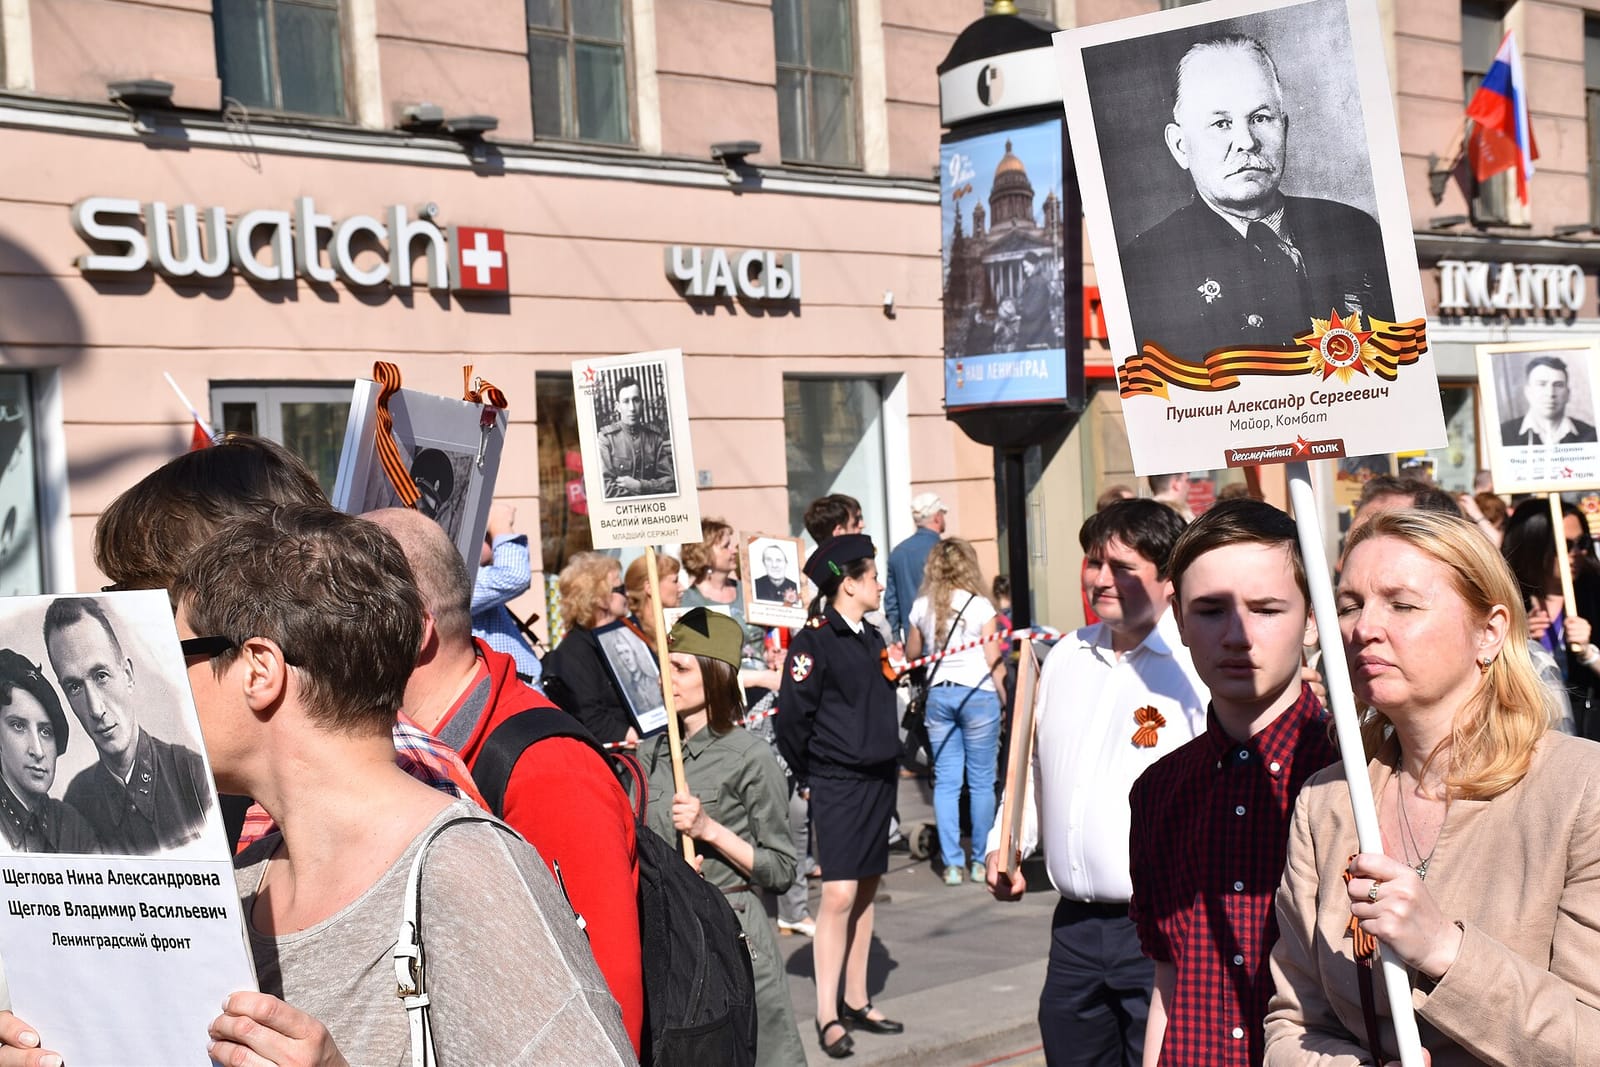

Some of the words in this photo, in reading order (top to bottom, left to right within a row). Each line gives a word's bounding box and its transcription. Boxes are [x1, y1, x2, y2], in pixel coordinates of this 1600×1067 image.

[72, 197, 448, 289] swatch
[664, 246, 801, 299] ЧАСЫ
[1437, 260, 1586, 310] INCANTO
[987, 359, 1049, 380] ЛЕНИНГРАД
[1166, 404, 1223, 424] Пушкин
[1227, 394, 1306, 414] Александр
[1309, 386, 1389, 406] Сергеевич
[1229, 416, 1274, 432] Майор,
[1276, 411, 1328, 427] Комбат
[615, 502, 667, 515] СИТНИКОВ
[600, 516, 640, 528] ВАСИЛИЙ
[641, 514, 689, 525] ИВАНОВИЧ
[612, 530, 645, 541] МЛАДШИЙ
[647, 528, 679, 539] СЕРЖАНТ
[2, 868, 64, 888] Щеглова
[66, 868, 104, 885] Нина
[107, 869, 221, 889] Александровна
[7, 900, 61, 919] Щеглов
[64, 901, 137, 921] Владимир
[139, 902, 228, 920] Васильевич
[52, 932, 148, 950] Ленинградский
[150, 933, 191, 952] фронт
